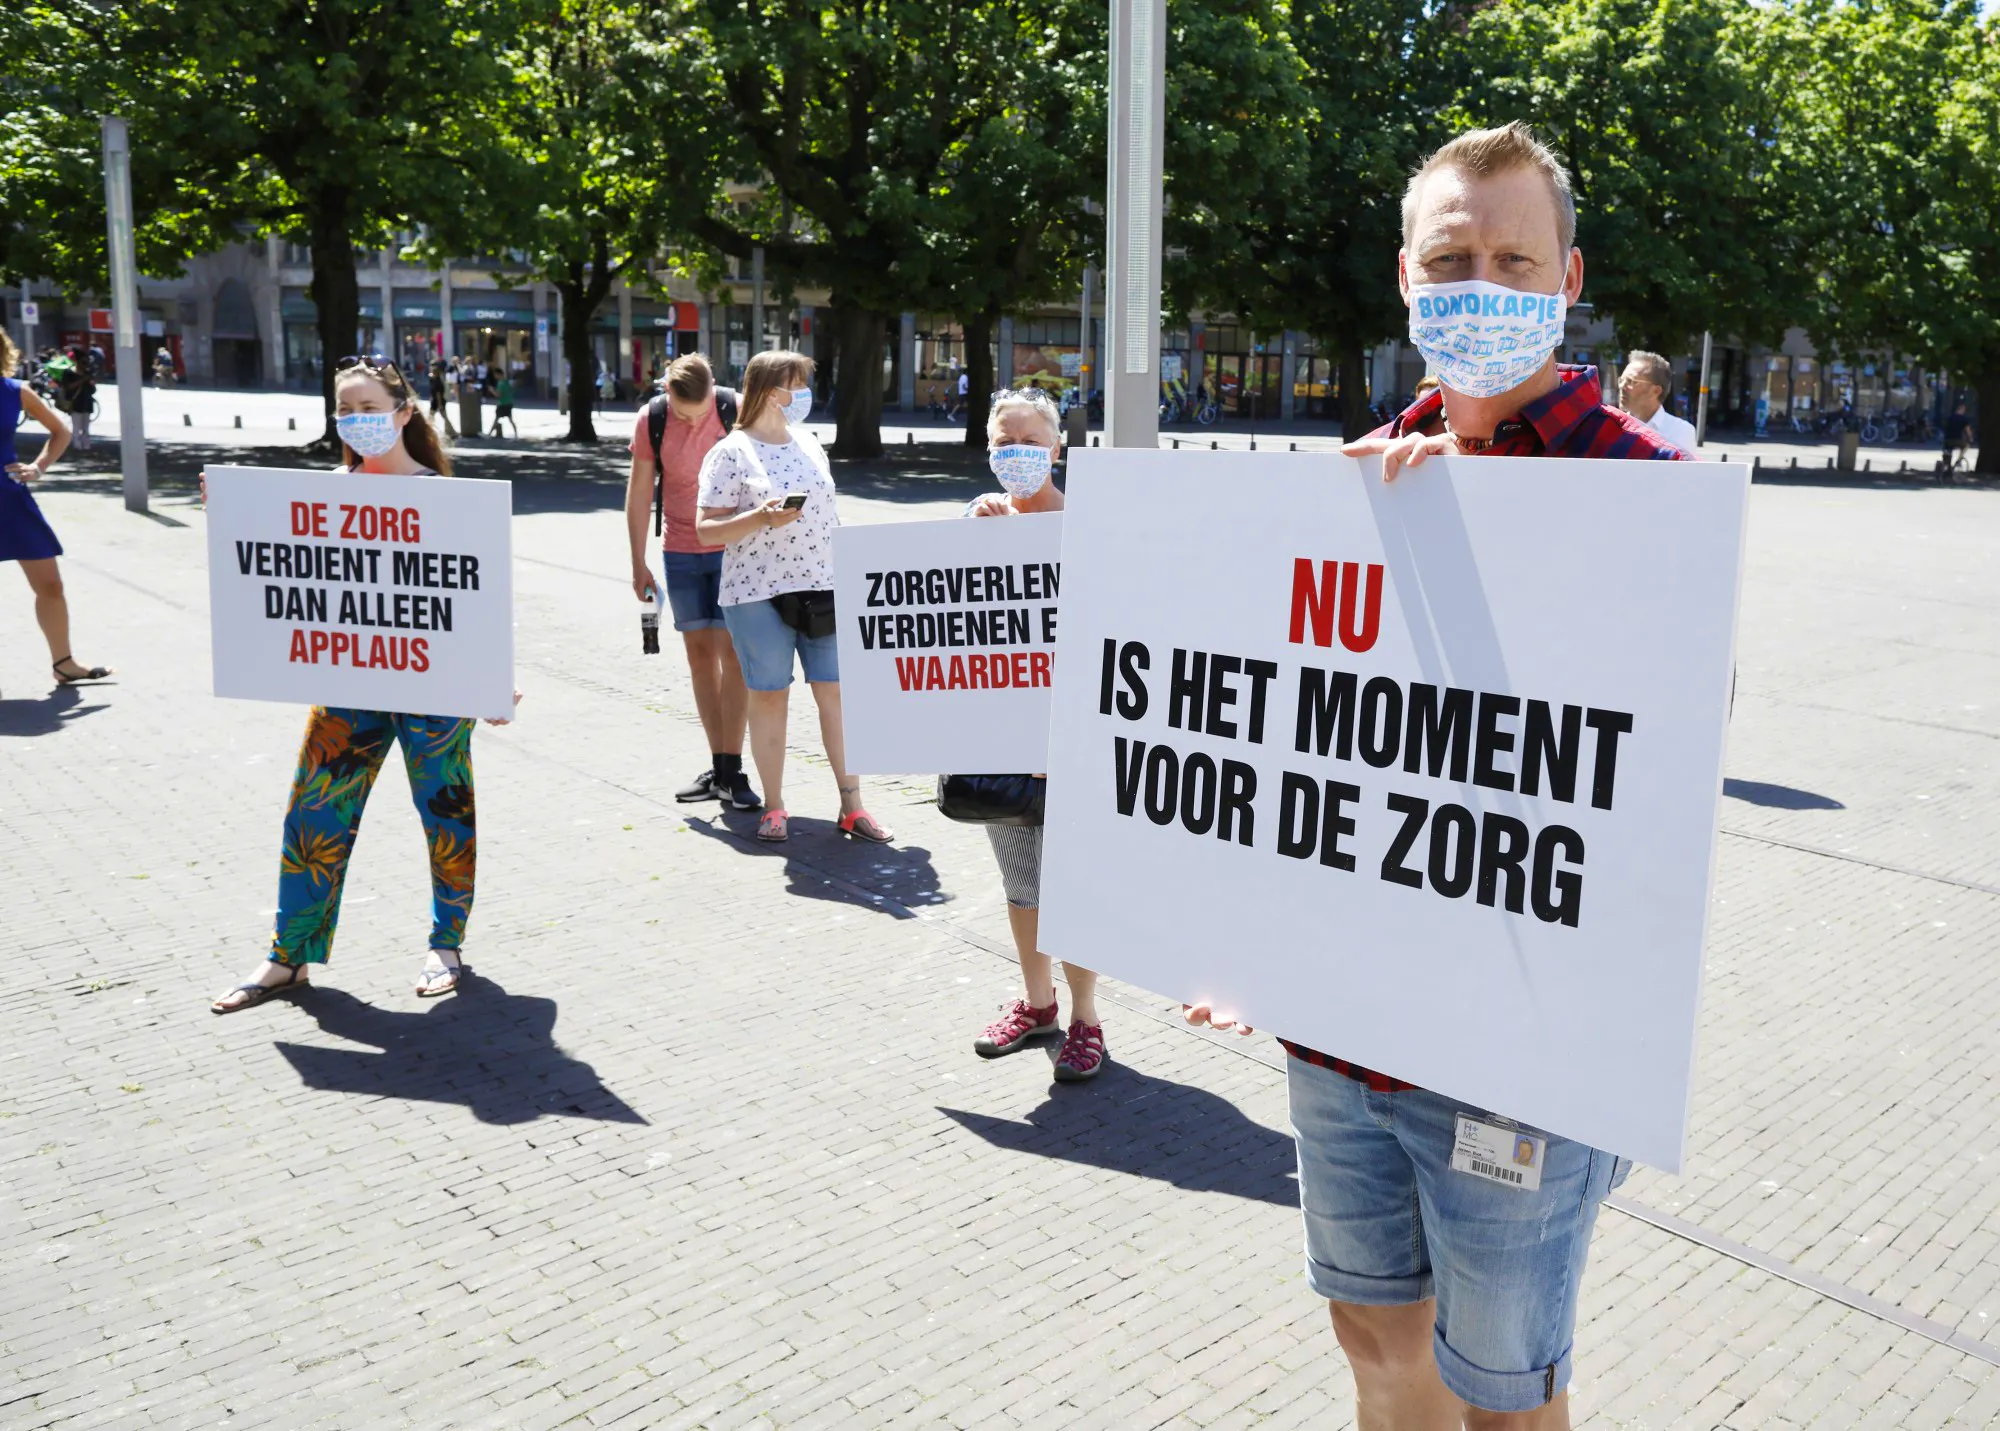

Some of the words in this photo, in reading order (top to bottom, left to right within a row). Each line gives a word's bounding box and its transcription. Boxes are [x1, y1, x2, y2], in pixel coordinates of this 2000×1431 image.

[475, 310, 506, 319] ONLY
[291, 501, 329, 537] DE
[339, 504, 420, 543] ZORG
[236, 540, 381, 584] VERDIENT
[393, 550, 479, 590] MEER
[865, 562, 1061, 607] ZORGVERLEN
[264, 584, 327, 623] DAN
[339, 590, 452, 632] ALLEEN
[858, 608, 1031, 650] VERDIENEN
[1041, 607, 1058, 643] E
[1289, 558, 1384, 653] NU
[289, 629, 430, 673] APPLAUS
[1099, 638, 1151, 721] IS
[1168, 648, 1278, 744] HET
[1295, 666, 1634, 811] MOMENT
[1114, 736, 1258, 847] VOOR
[1277, 770, 1361, 873] DE
[1380, 791, 1586, 929] ZORG
